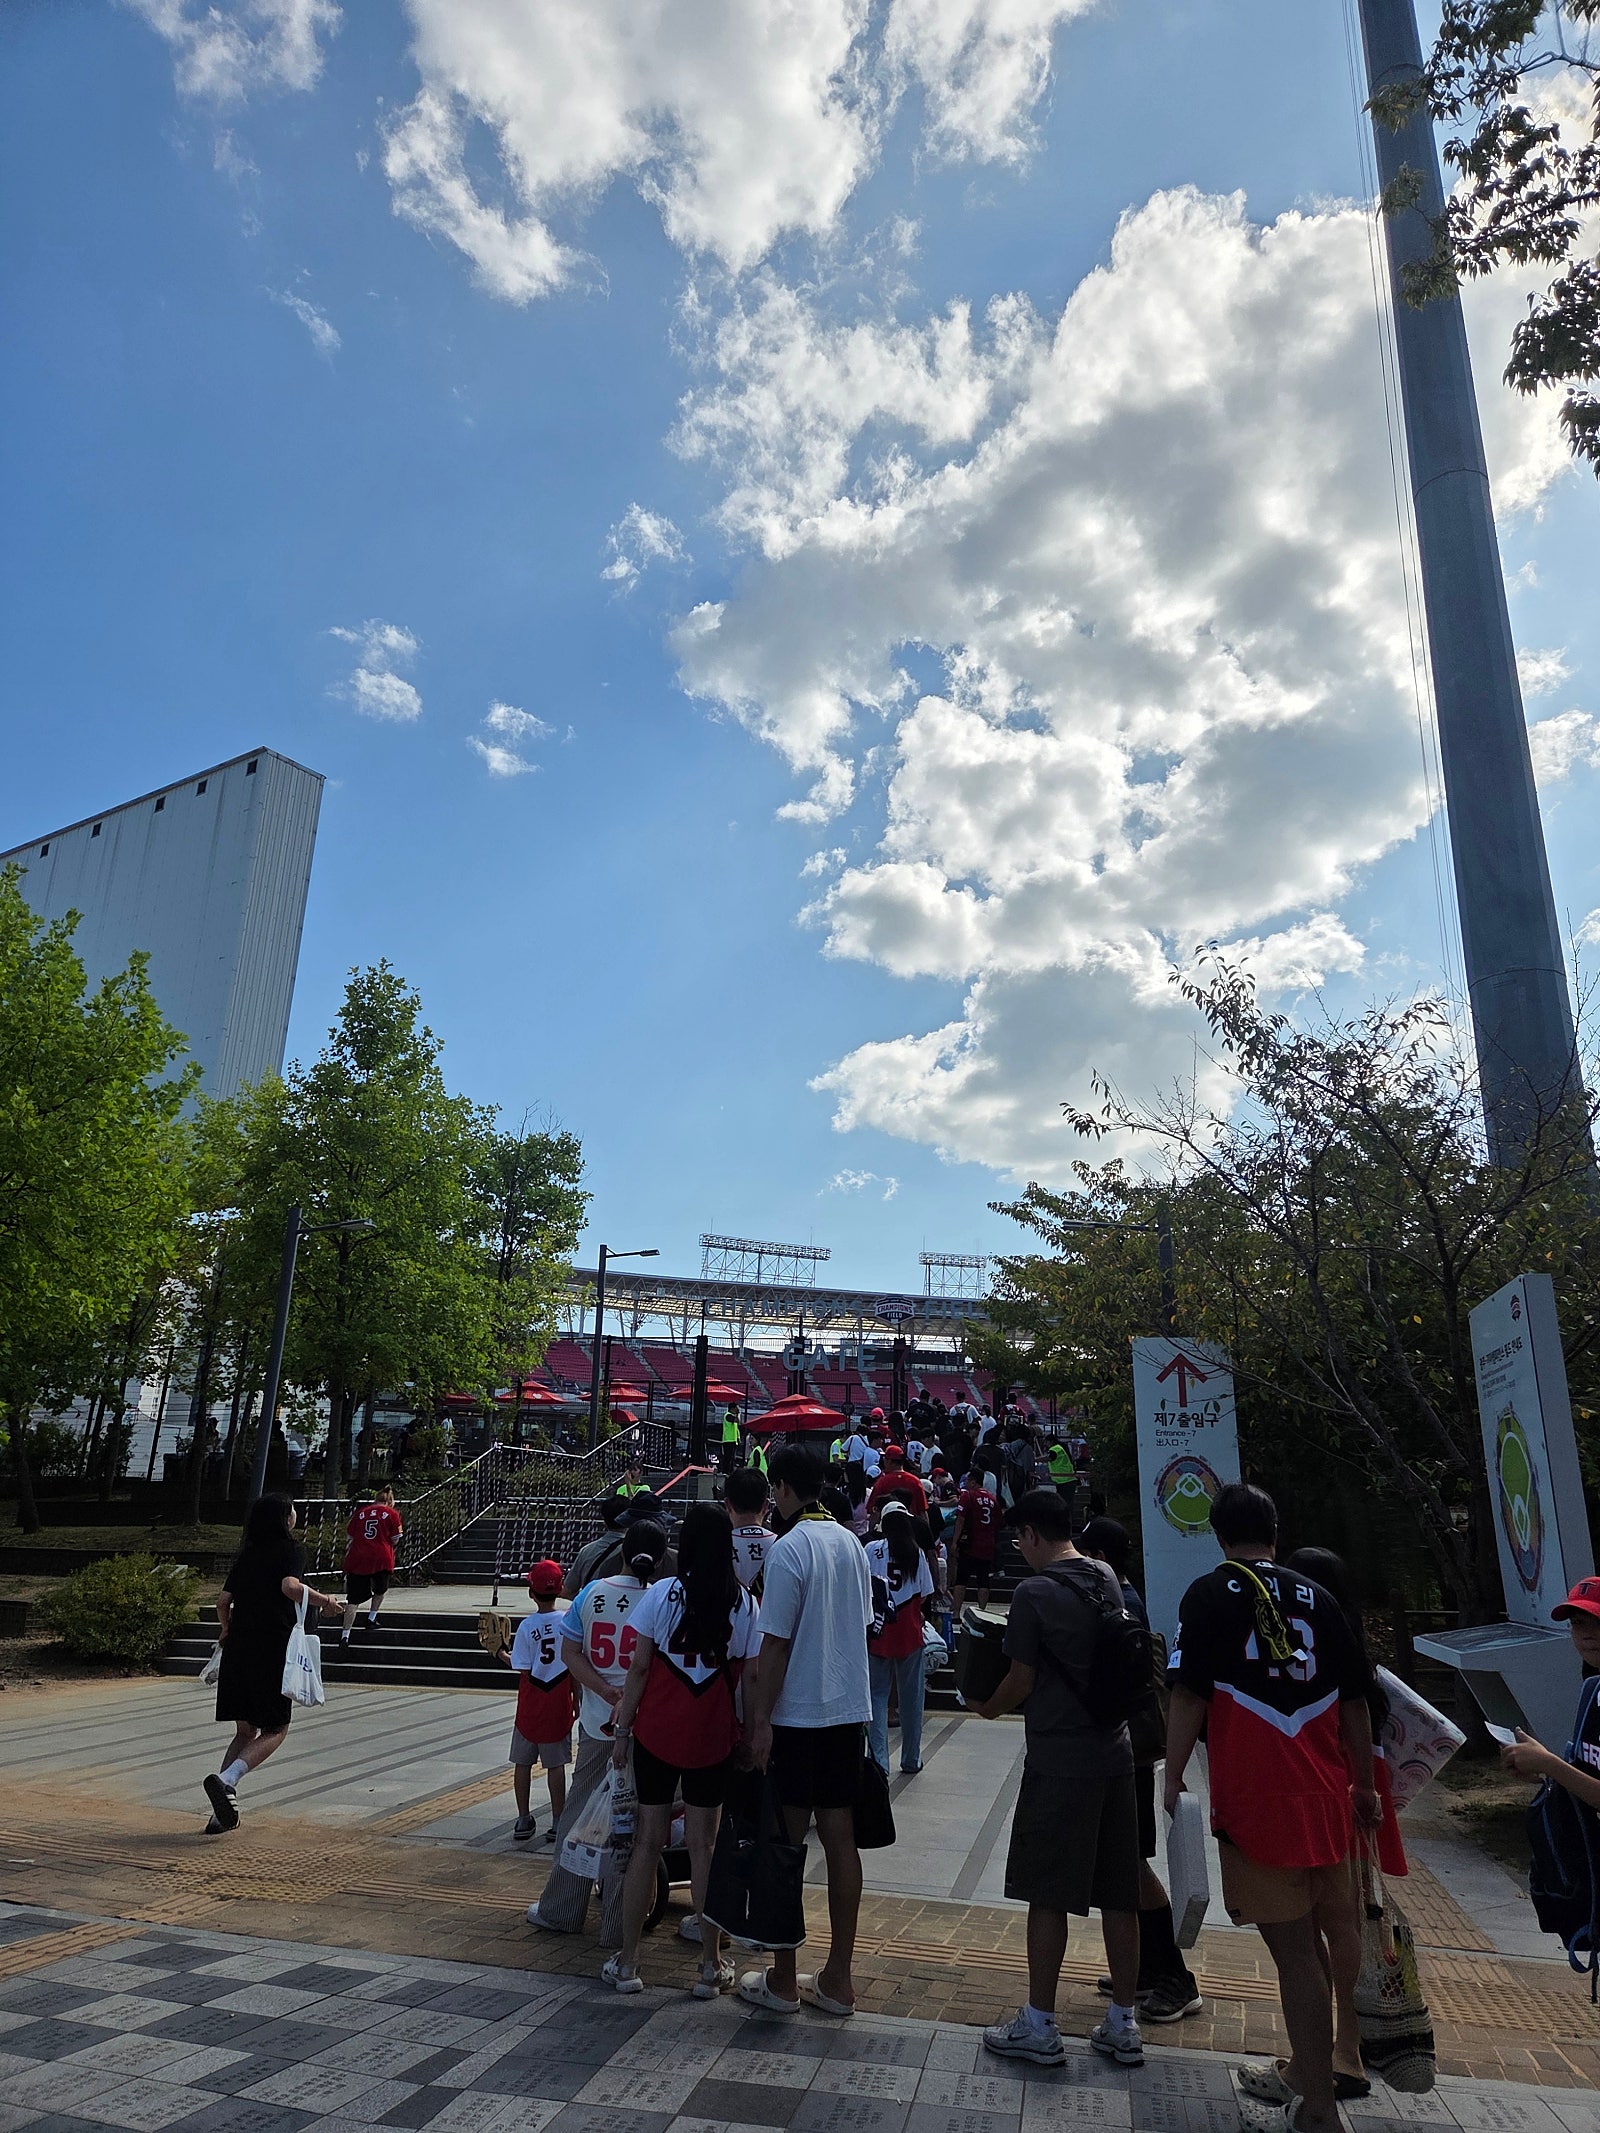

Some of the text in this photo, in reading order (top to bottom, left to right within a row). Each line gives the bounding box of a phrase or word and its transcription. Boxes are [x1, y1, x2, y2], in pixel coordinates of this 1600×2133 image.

[704, 1300, 863, 1318] CHAMPIONS
[877, 1303, 913, 1313] CHAMPIONS
[782, 1342, 878, 1372] GATE
[1153, 1412, 1220, 1428] 제7출입구
[980, 1506, 991, 1524] 3
[364, 1519, 379, 1540] 5
[887, 1561, 903, 1591] 5
[1579, 1581, 1597, 1597] T
[531, 1623, 564, 1642] 김도
[540, 1637, 555, 1665] 5
[590, 1622, 638, 1669] 55
